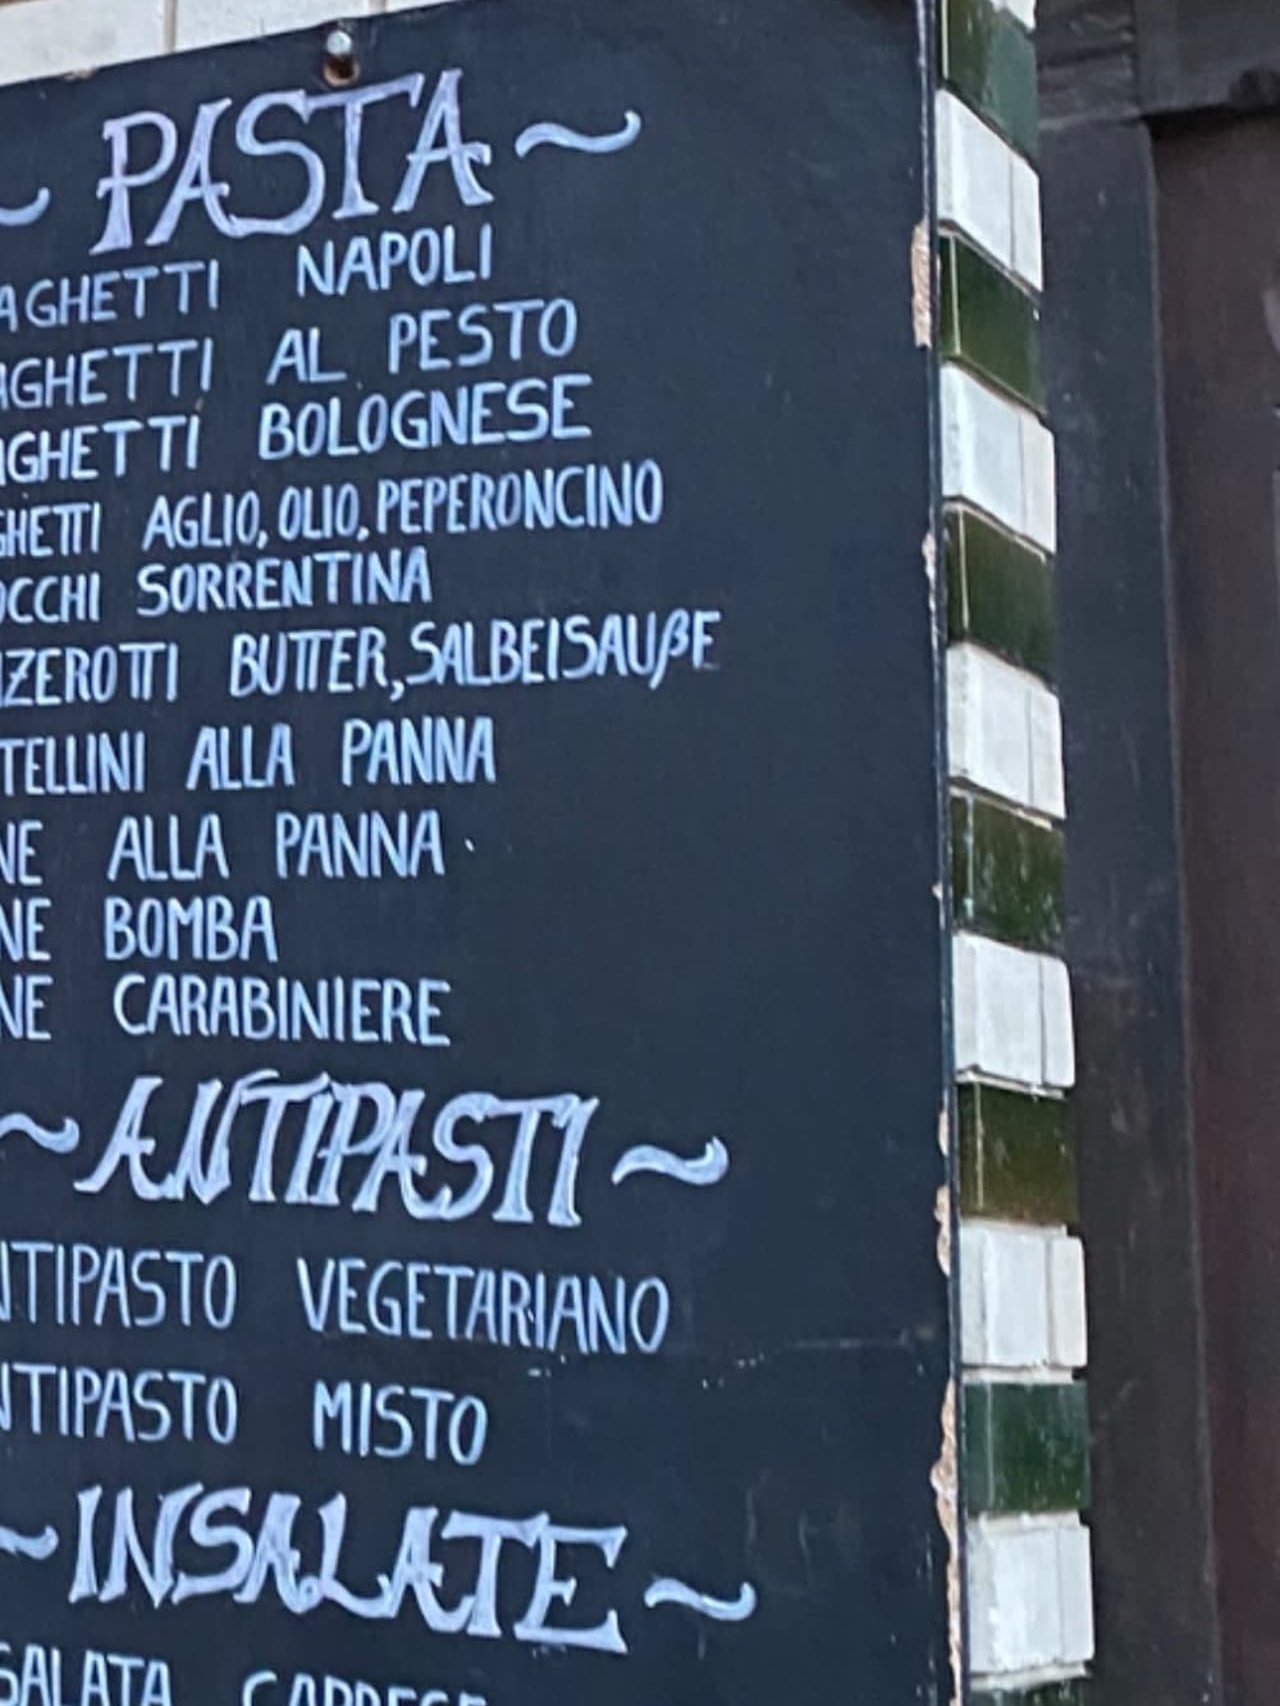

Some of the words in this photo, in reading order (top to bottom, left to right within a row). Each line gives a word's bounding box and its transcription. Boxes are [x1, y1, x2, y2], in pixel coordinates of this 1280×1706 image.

[88, 68, 494, 256] PASTA
[296, 223, 493, 297] NAPOLI
[266, 328, 346, 384] AL
[388, 298, 578, 374] PESTO
[258, 374, 593, 460] BOLOGNESE
[143, 491, 269, 551] AGLIO,
[278, 483, 370, 542] OLIO,
[377, 458, 664, 534] PEPERONCINO
[137, 546, 432, 617] SORRENTINA
[229, 629, 405, 701] BUTTER,
[185, 723, 294, 791] ALLA
[341, 715, 496, 788] PANNA
[107, 813, 230, 882] ALLA
[275, 809, 445, 878] PANNA
[105, 895, 277, 963] BOMBA
[114, 973, 451, 1046] CARABINIERE
[73, 1068, 600, 1227] ANTIPASTI
[296, 1257, 670, 1355] VEGETARIANO
[313, 1380, 488, 1466] MISTO
[68, 1483, 628, 1656] INSALATE
